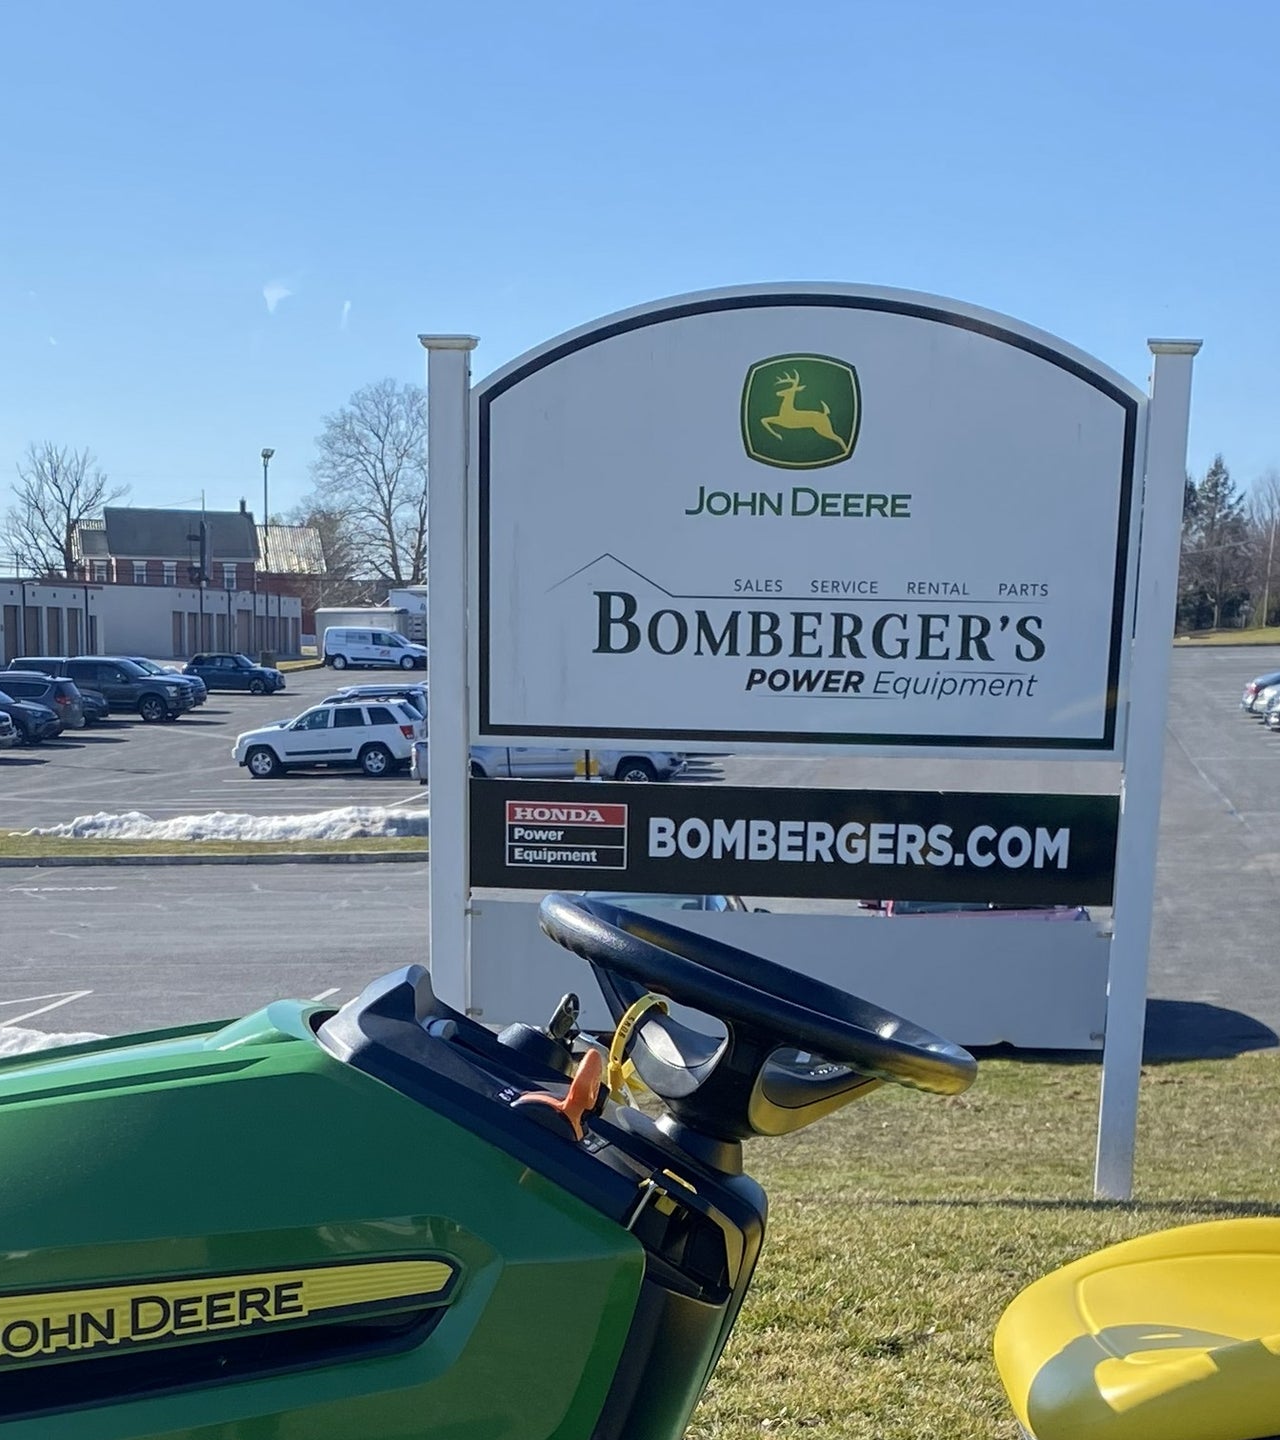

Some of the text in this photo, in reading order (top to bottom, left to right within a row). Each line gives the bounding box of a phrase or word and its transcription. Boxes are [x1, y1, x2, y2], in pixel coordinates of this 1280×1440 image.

[685, 486, 912, 518] JOHN DEERE
[734, 578, 1049, 597] SALES SERVICE RENTAL PARTS
[592, 591, 1046, 662] BOMBERGER'S
[745, 668, 1038, 700] POWER Equipment
[513, 807, 605, 822] HONDA
[513, 827, 565, 840] Power
[648, 817, 1070, 869] BOMBERGERS.COM
[513, 848, 598, 863] Equipment
[130, 1281, 304, 1337] DEERE
